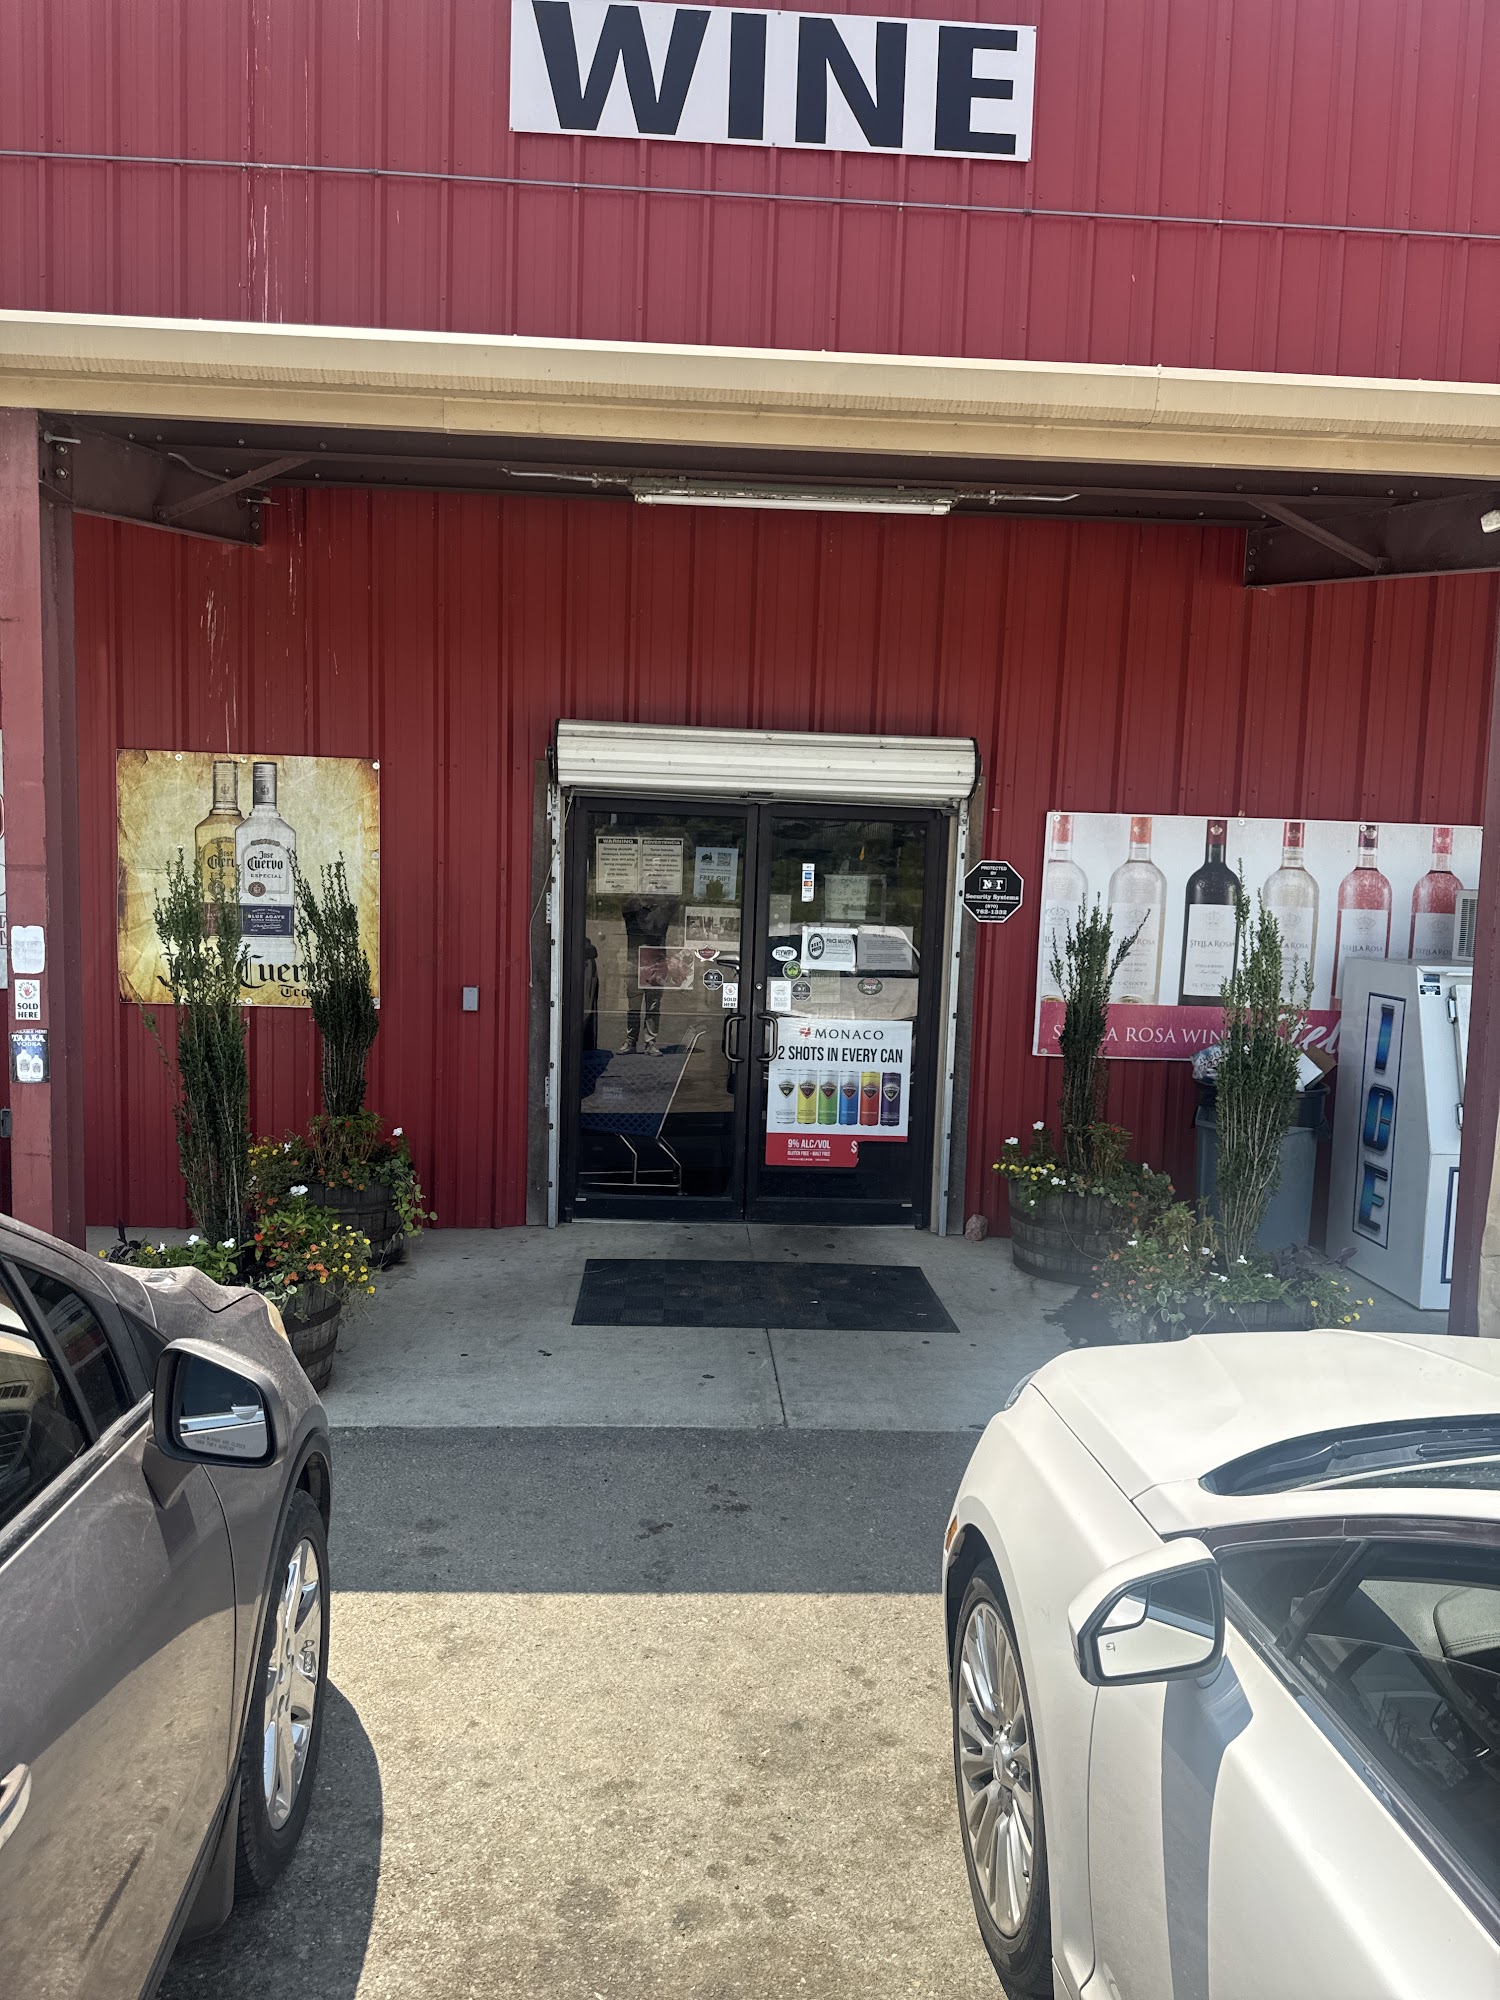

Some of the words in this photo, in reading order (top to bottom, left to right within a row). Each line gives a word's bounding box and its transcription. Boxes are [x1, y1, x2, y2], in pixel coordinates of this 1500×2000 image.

[532, 0, 1018, 155] WINE
[247, 856, 283, 871] Cuervo
[1190, 940, 1213, 948] STELLA
[815, 1028, 884, 1040] MONACO
[1126, 1027, 1176, 1043] ROSA
[778, 1045, 785, 1060] 2
[788, 1046, 824, 1061] SHOTS
[827, 1047, 839, 1062] IN
[842, 1047, 877, 1063] EVERY
[880, 1049, 903, 1063] CAN
[1358, 1003, 1394, 1235] ICE
[787, 1139, 800, 1148] 9%
[801, 1139, 831, 1149] ALC/VOL
[851, 1140, 858, 1154] $
